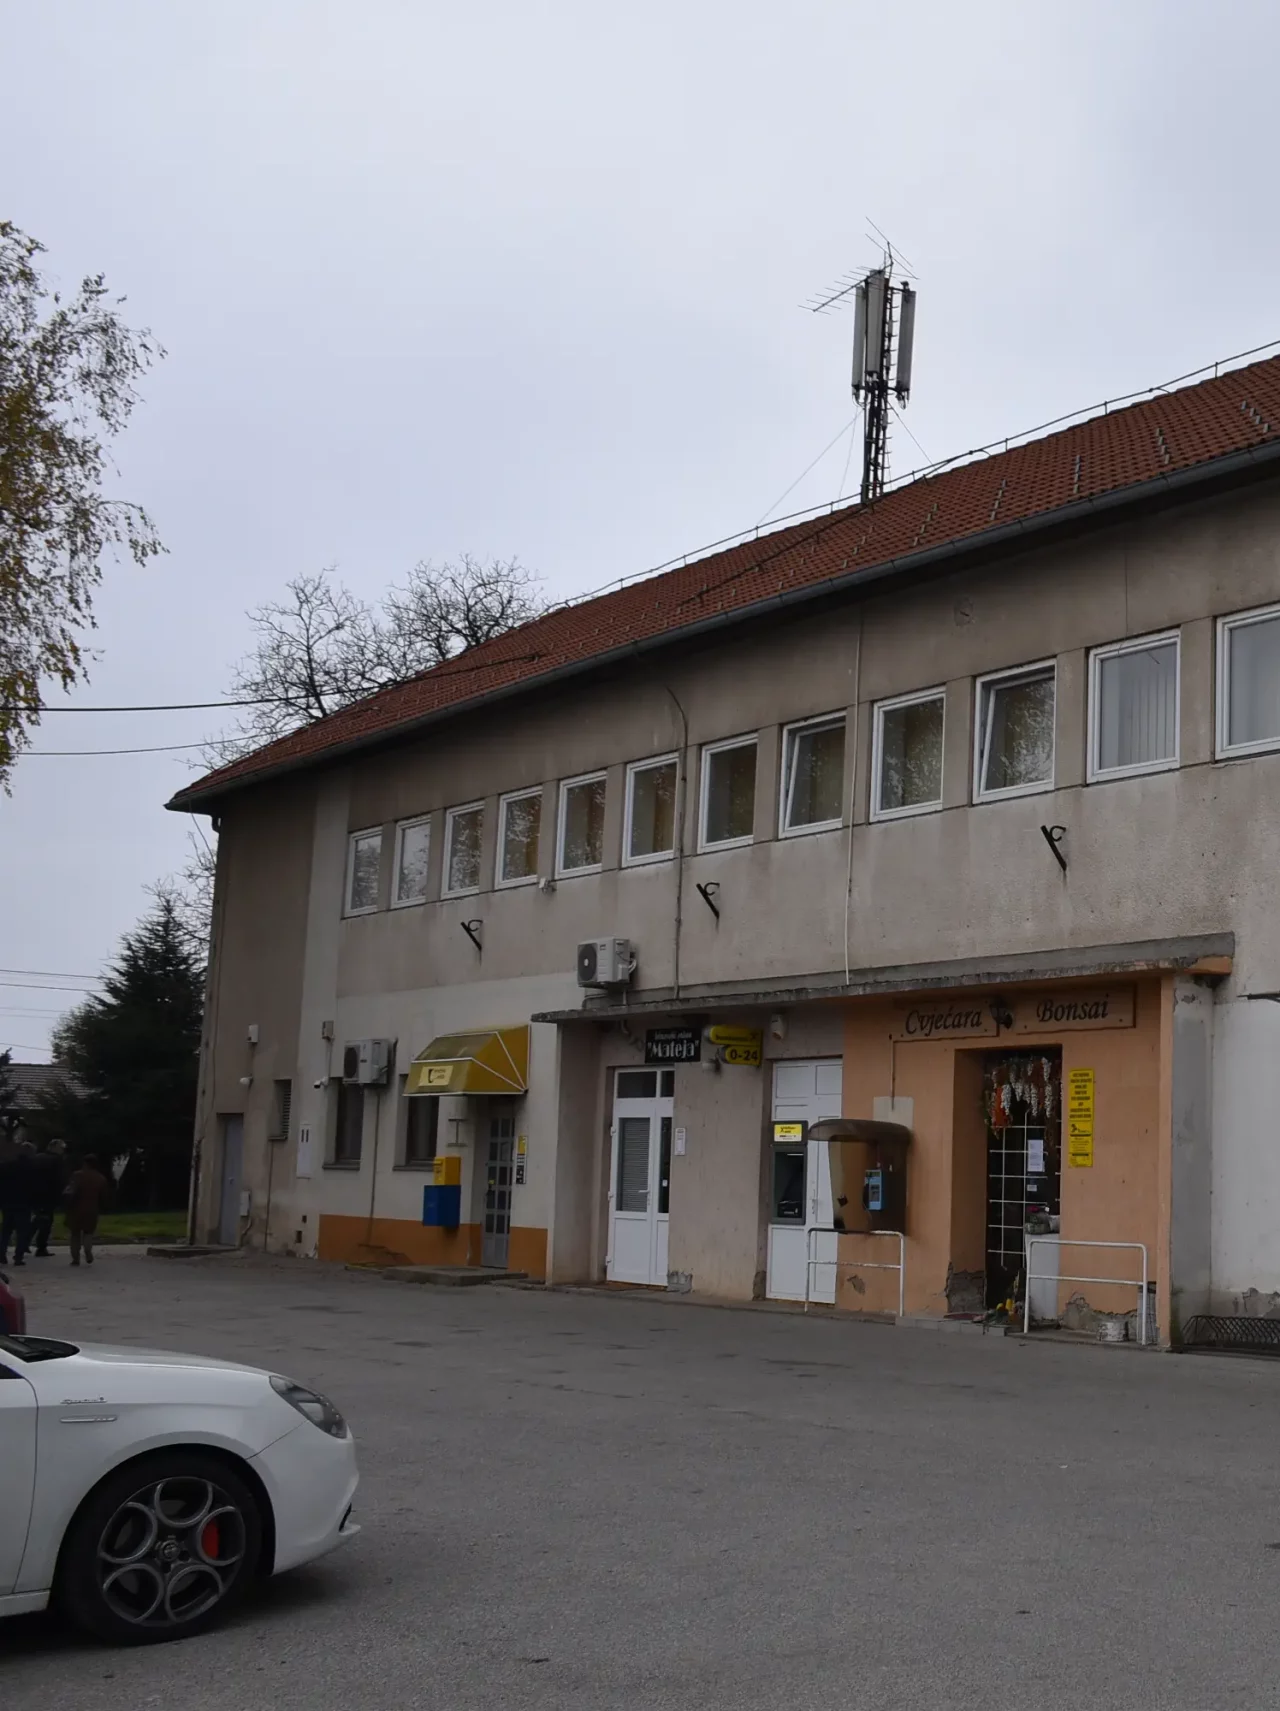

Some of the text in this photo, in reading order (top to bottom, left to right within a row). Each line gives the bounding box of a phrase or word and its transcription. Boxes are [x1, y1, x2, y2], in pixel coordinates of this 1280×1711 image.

[905, 993, 1109, 1037] Cvjećara Bonsai
[647, 1039, 699, 1059] "Mateja"
[730, 1048, 758, 1061] 0-24
